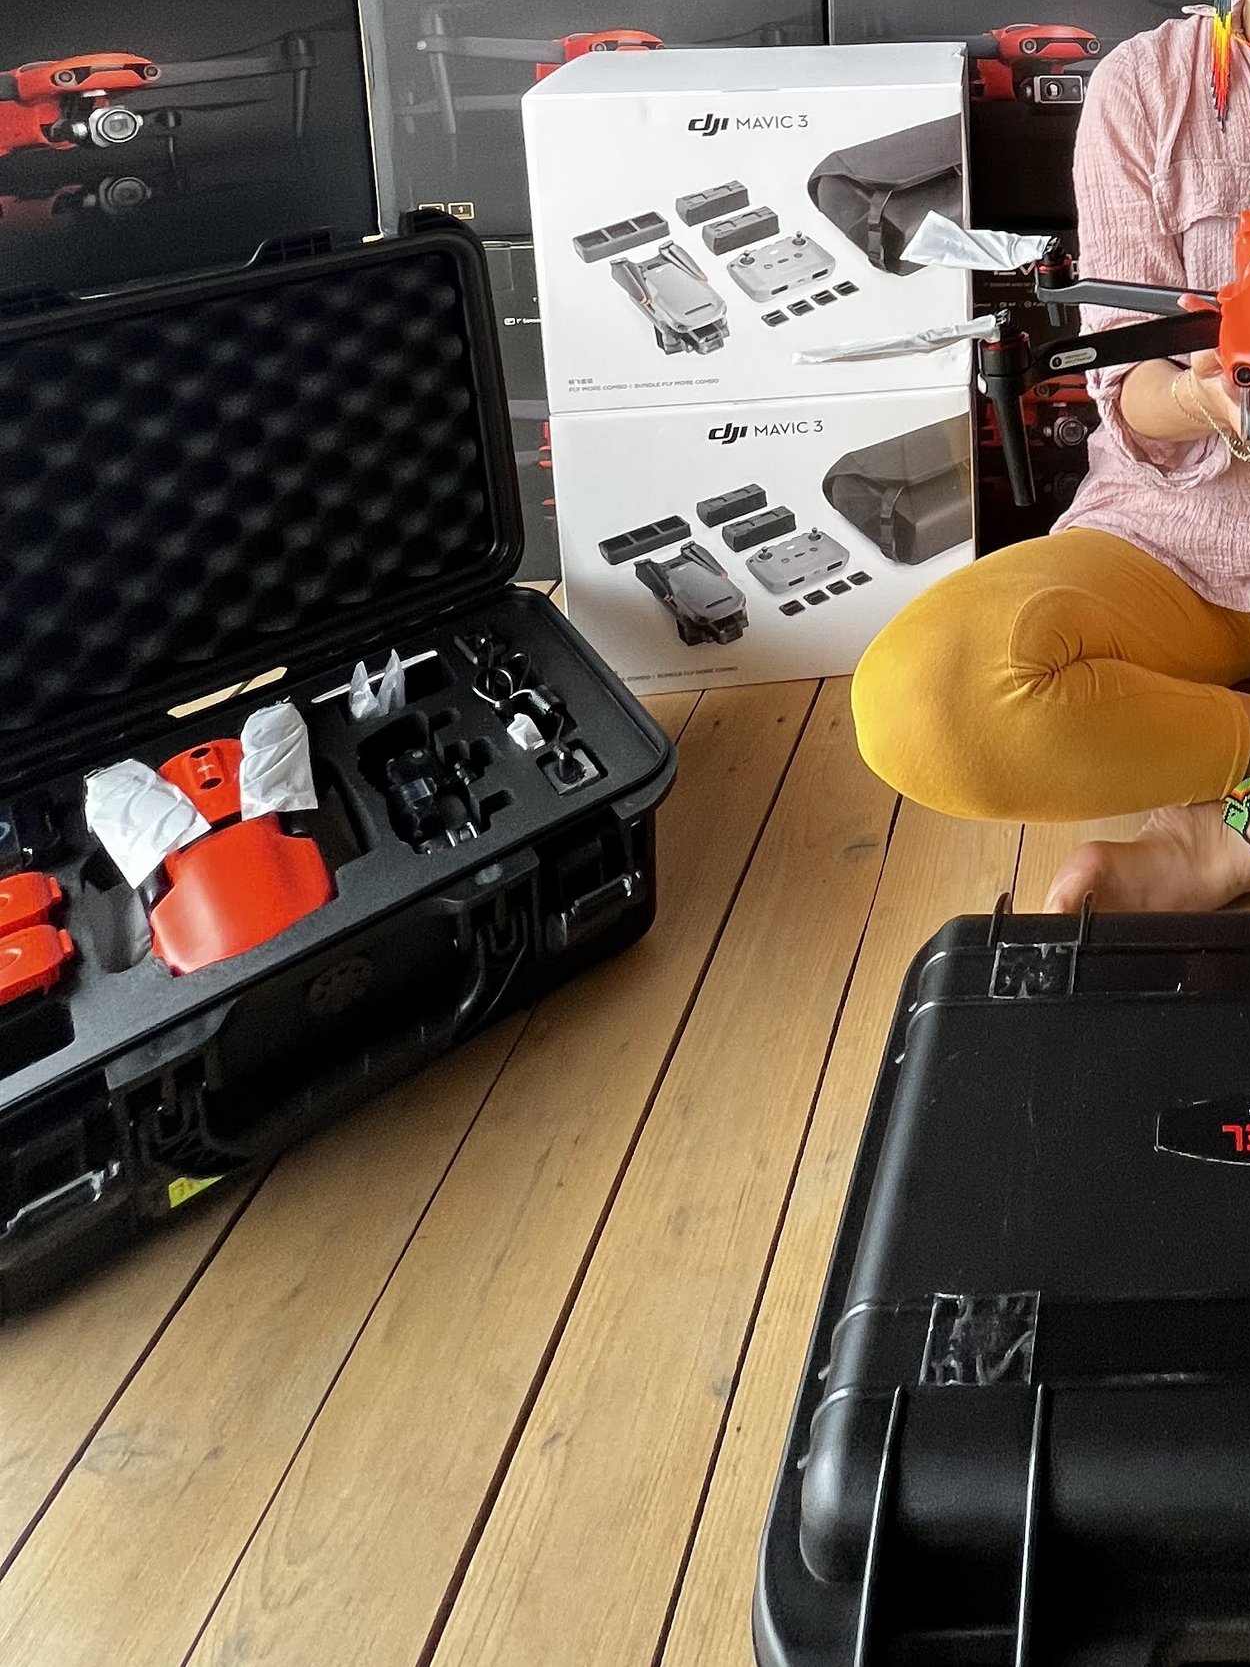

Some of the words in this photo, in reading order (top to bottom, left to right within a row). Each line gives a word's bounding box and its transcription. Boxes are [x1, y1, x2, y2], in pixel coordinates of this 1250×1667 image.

[736, 115, 794, 130] MAVIC
[798, 115, 809, 128] 3
[754, 421, 809, 437] MAVIC
[813, 420, 824, 433] 3
